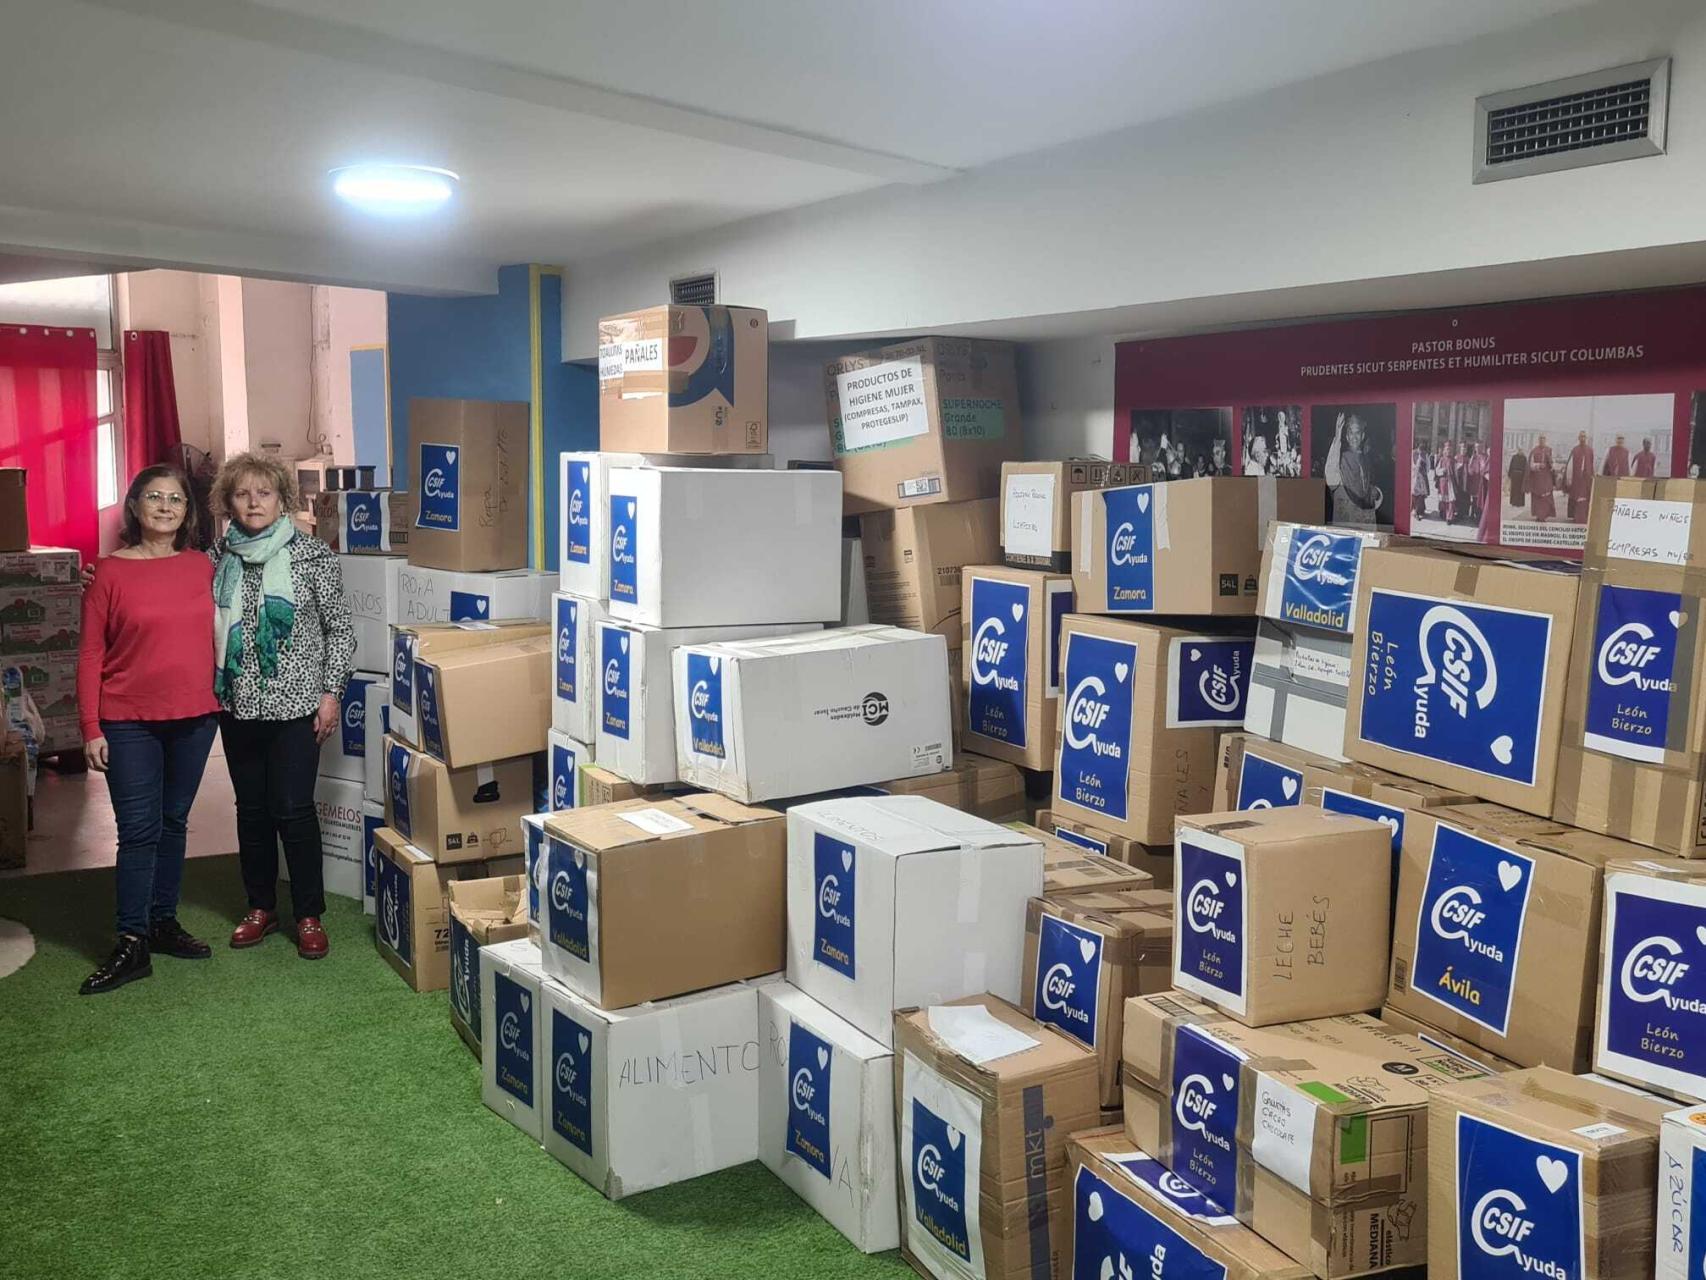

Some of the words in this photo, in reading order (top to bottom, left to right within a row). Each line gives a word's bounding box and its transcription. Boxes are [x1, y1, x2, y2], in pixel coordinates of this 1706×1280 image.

[624, 343, 658, 364] PAÑALES
[1411, 338, 1453, 354] PASTOR
[1456, 336, 1496, 351] BONUS
[1300, 362, 1355, 377] PRUDENTES
[1356, 360, 1386, 374] SICUT
[1387, 357, 1446, 373] SERPENTES
[1447, 356, 1463, 369] ET
[1464, 352, 1528, 368] HUMILITER
[1530, 349, 1568, 364] SICUT
[1569, 344, 1644, 362] COLUMBAS
[846, 370, 899, 391] PRODUCTOS
[900, 367, 913, 379] DE
[849, 390, 883, 407] HIGIENE
[885, 383, 915, 399] MUJER
[844, 404, 890, 423] (COMPRESAS,
[891, 397, 923, 412] TAMPAX,
[861, 413, 909, 431] PROTEGESLIP)
[943, 412, 977, 424] Grande
[425, 510, 453, 523] Zamora
[1116, 534, 1137, 551] CSIF
[1302, 547, 1333, 567] CSIF
[1113, 586, 1147, 601] Zamora
[1285, 601, 1345, 629] Valladolid
[977, 636, 1008, 665] CSIF
[1607, 642, 1662, 668] CSIF
[1368, 630, 1384, 697] Bierzo
[1383, 641, 1399, 692] León
[1441, 628, 1474, 719] CSIF
[1211, 663, 1228, 703] CSIF
[862, 700, 890, 717] MCI
[984, 703, 1005, 722] León
[1072, 696, 1110, 729] CSIF
[1617, 703, 1648, 719] León
[982, 719, 1008, 739] Bierzo
[1611, 718, 1652, 736] Bierzo
[1079, 769, 1102, 789] León
[1075, 787, 1106, 808] Bierzo
[315, 801, 362, 824] GEMELOS
[556, 880, 574, 898] CSIF
[824, 886, 842, 906] CSIF
[1193, 894, 1225, 919] CSIF
[1441, 898, 1486, 929] CSIF
[820, 937, 849, 966] Zamora
[1202, 948, 1222, 965] León
[1272, 910, 1295, 982] LECHE
[1198, 960, 1224, 980] Bierzo
[1632, 952, 1691, 986] CSIF
[1049, 974, 1076, 1000] CSIF
[1438, 965, 1481, 1006] Ávila
[503, 1019, 522, 1043] CSIF
[1646, 1022, 1680, 1041] León
[1640, 1037, 1685, 1060] Bierzo
[501, 1064, 529, 1095] Zamora
[559, 1060, 578, 1084] CSIF
[796, 1076, 816, 1101] CSIF
[1183, 1086, 1218, 1121] CSIF
[557, 1109, 586, 1142] Zamora
[795, 1129, 825, 1163] Zamora
[1026, 1128, 1046, 1180] mkt
[1193, 1147, 1215, 1169] León
[922, 1154, 946, 1181] CSIF
[1188, 1160, 1218, 1186] Bierzo
[916, 1204, 967, 1257] Valladolid
[1482, 1206, 1536, 1242] CSIF
[1368, 1212, 1380, 1270] MEDIANA
